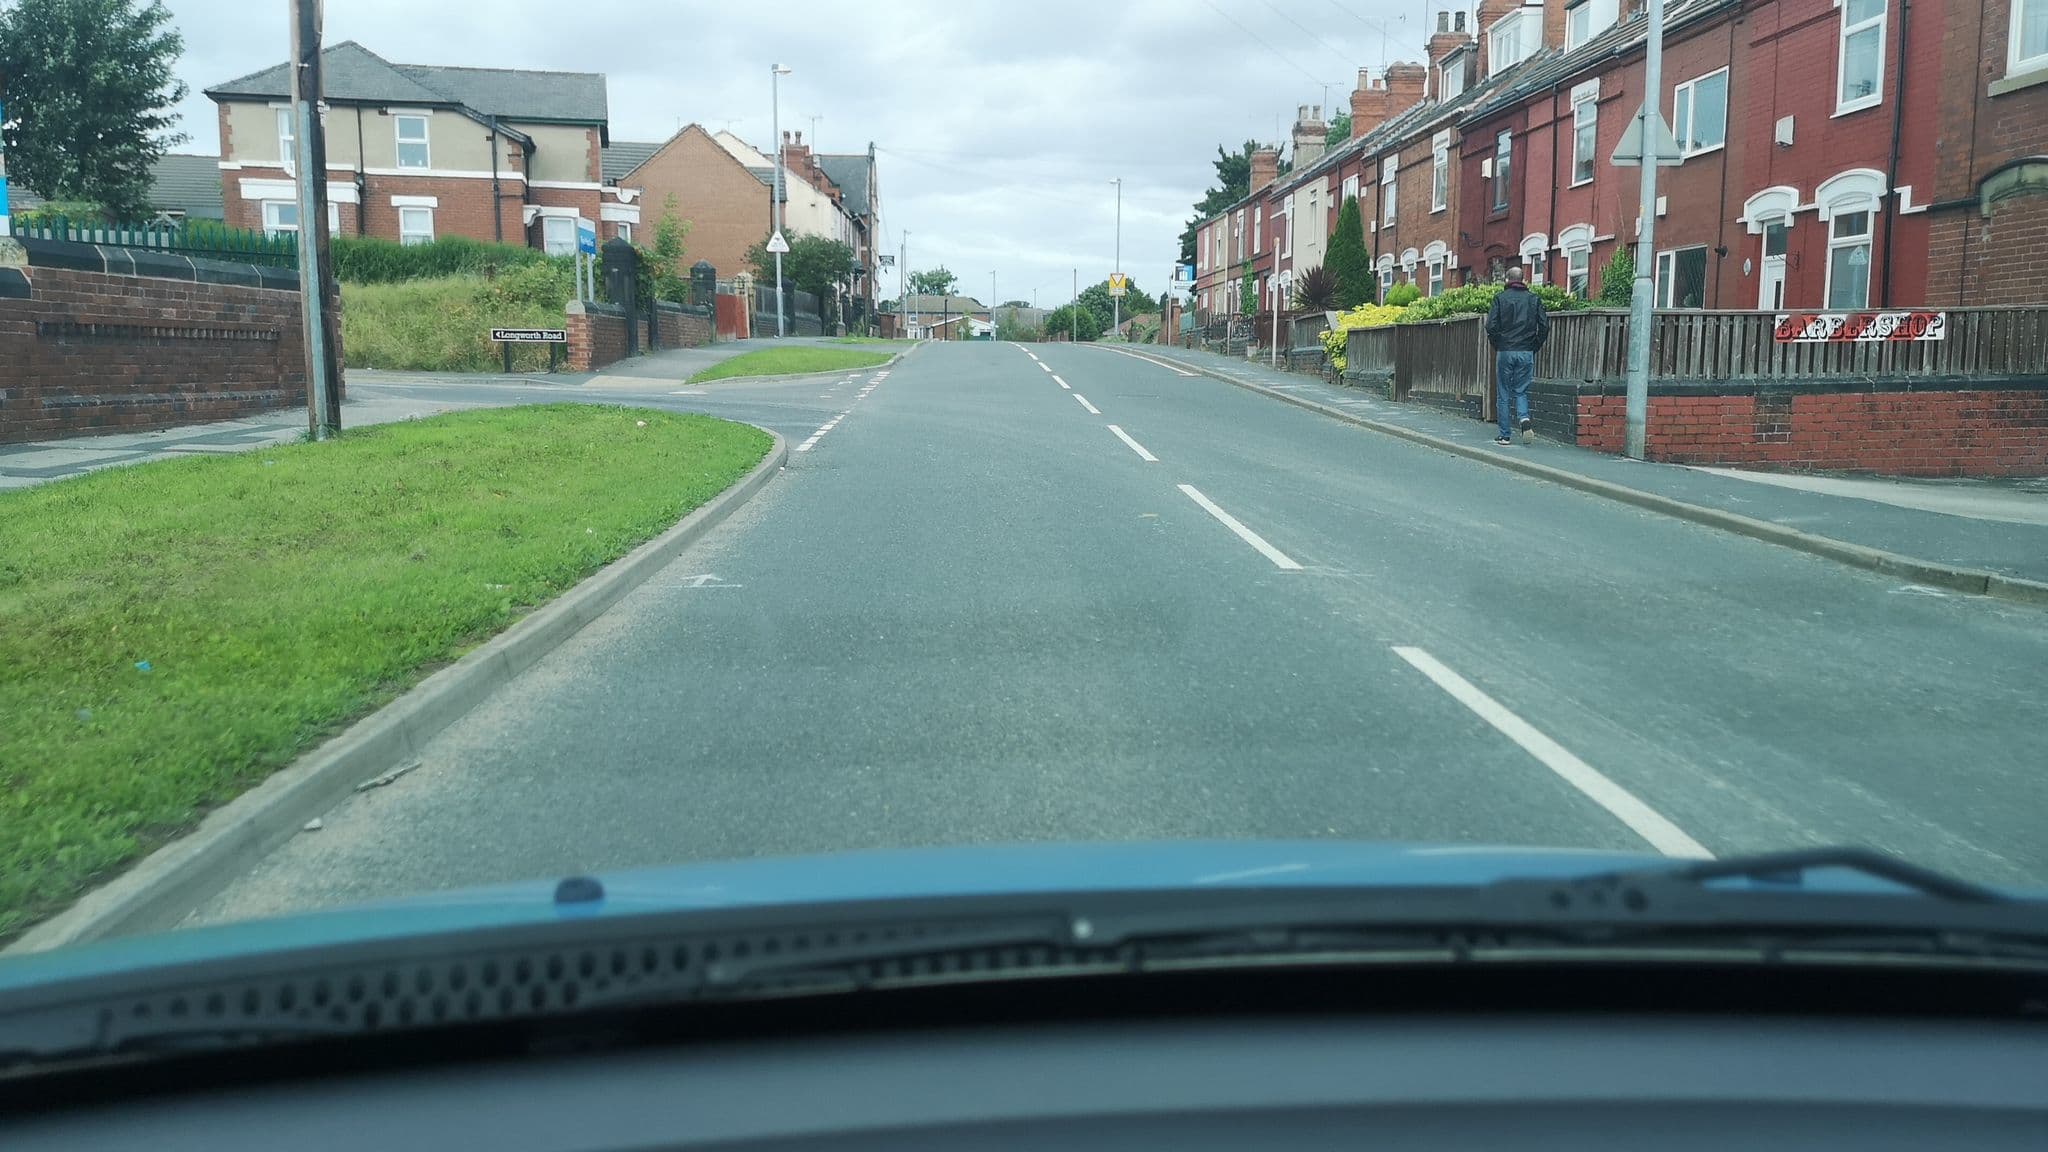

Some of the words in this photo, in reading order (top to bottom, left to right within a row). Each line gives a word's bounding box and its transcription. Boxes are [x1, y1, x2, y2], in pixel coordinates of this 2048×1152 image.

[501, 331, 541, 340] Longworth
[542, 332, 562, 340] Road
[1775, 314, 1944, 340] BARBERSHOP
